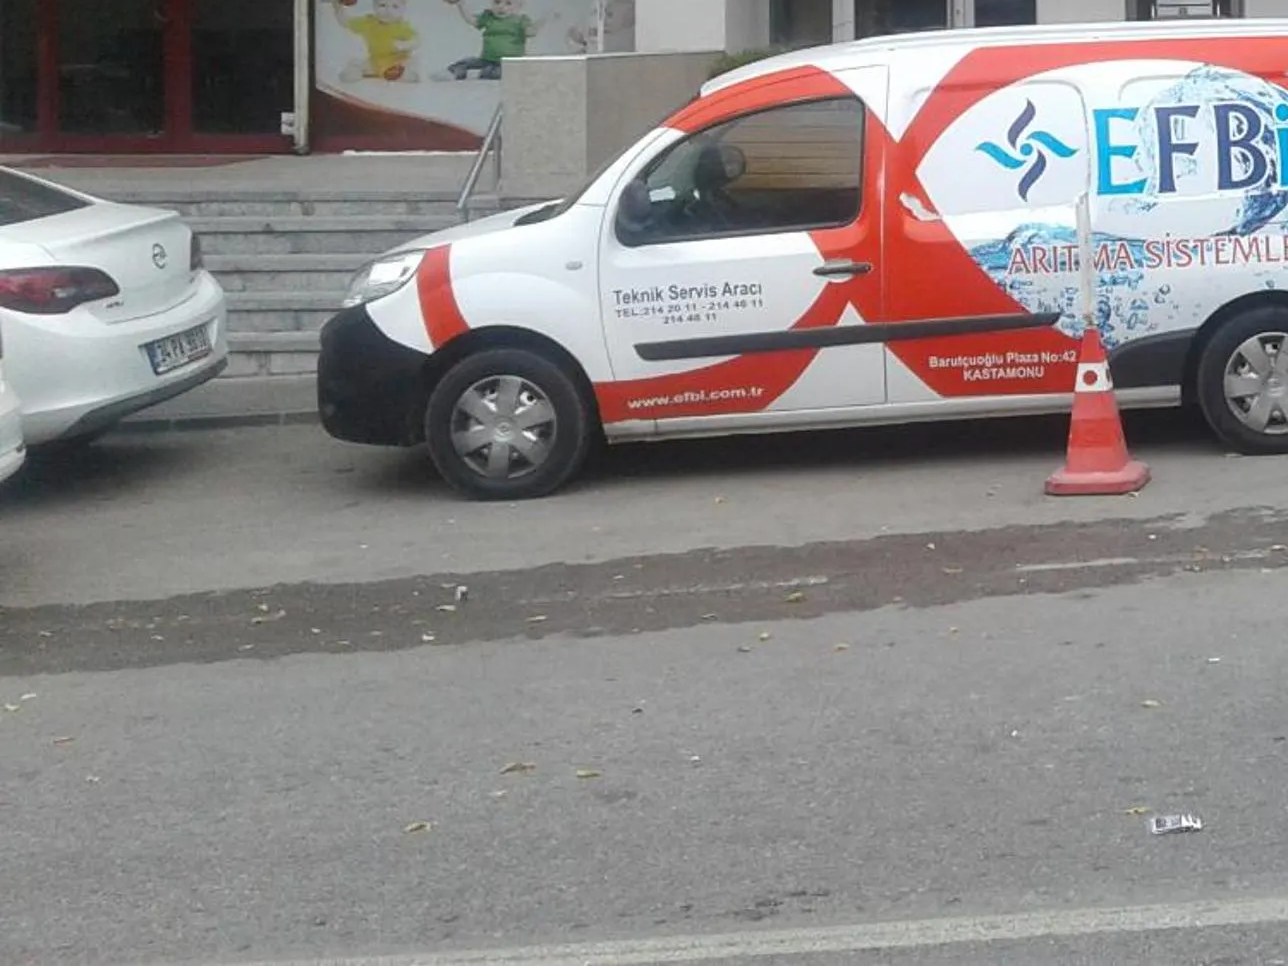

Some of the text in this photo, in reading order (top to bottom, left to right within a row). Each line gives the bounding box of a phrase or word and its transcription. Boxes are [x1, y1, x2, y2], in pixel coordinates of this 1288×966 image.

[1008, 241, 1135, 274] ARITMA
[613, 282, 762, 305] Teknik Servis Aracı
[929, 350, 1077, 368] Barutçuoğlu Plaza No:42
[963, 366, 1045, 381] KASTAMONU
[628, 386, 764, 409] www.efbi.com.tr
